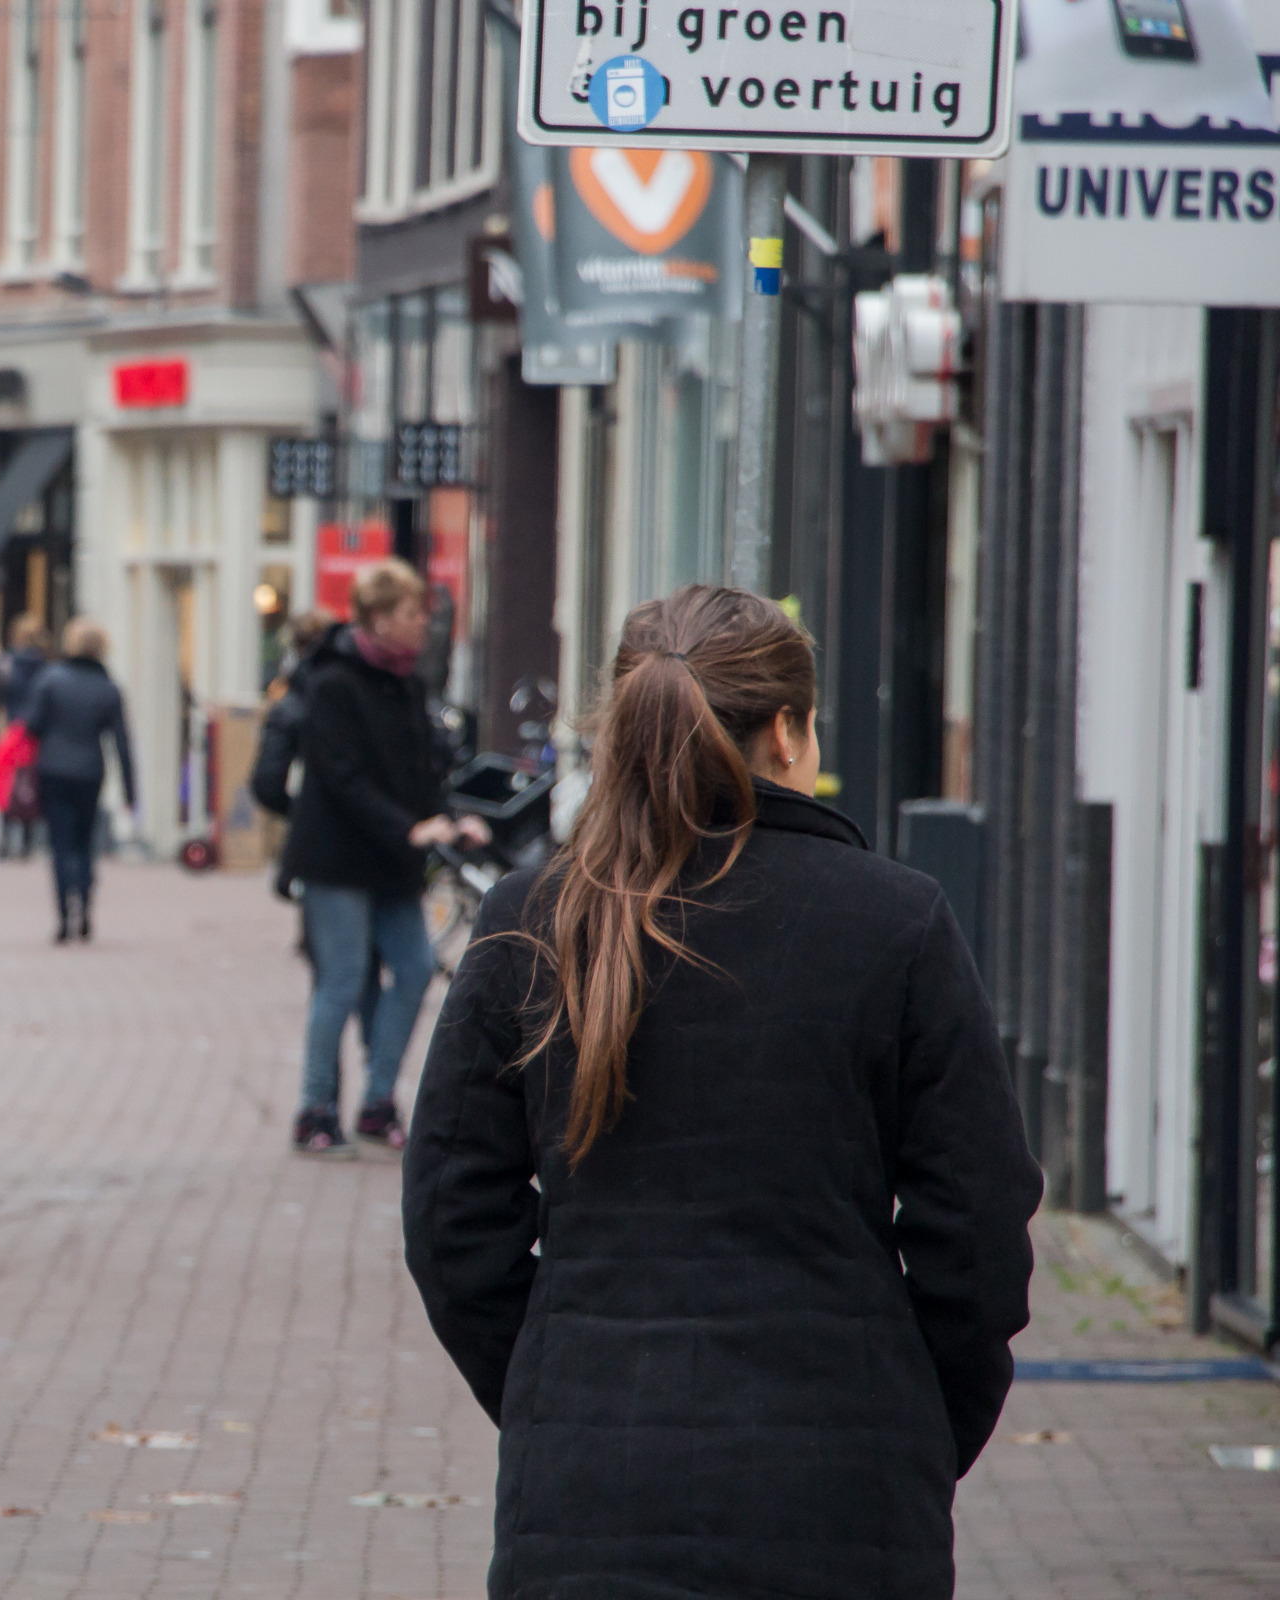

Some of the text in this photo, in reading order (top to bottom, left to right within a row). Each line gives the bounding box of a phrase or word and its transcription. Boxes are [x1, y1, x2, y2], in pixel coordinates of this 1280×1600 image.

[576, 0, 847, 54] bij groen
[700, 70, 962, 128] voertuig
[1036, 166, 1276, 221] UNIVERS
